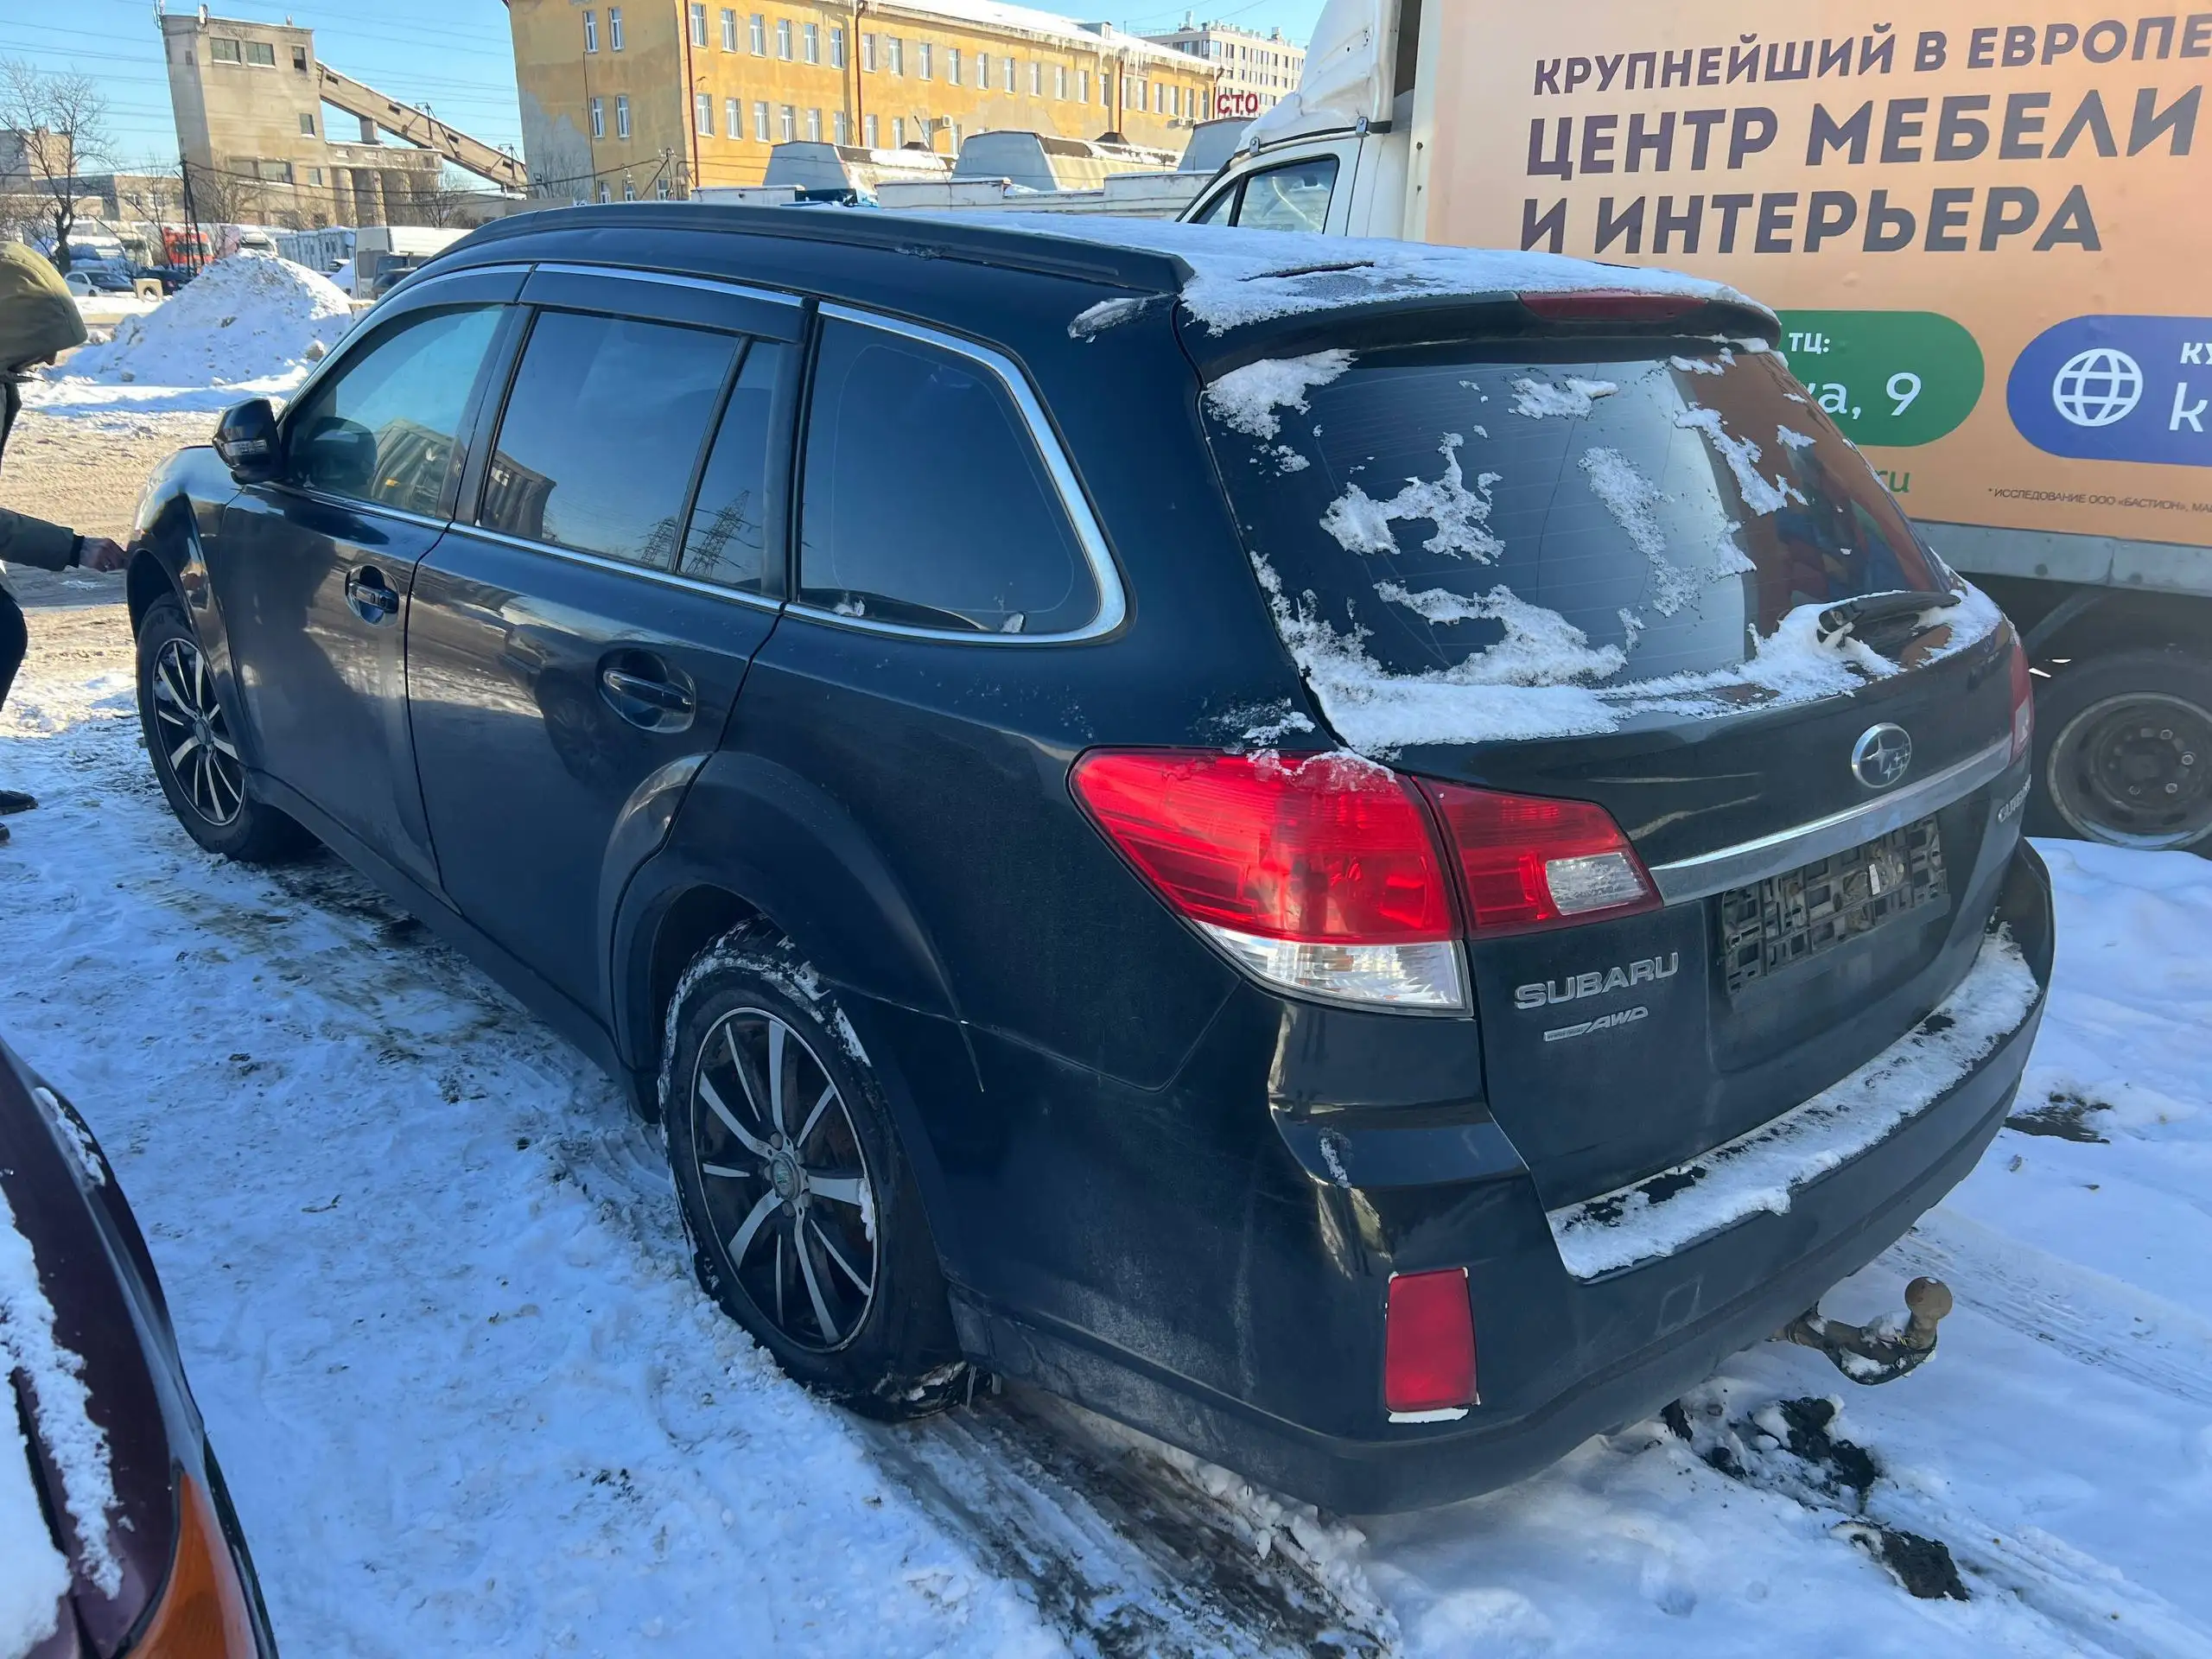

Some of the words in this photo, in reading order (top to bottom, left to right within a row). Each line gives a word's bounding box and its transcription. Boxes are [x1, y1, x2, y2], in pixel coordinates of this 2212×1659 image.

[1534, 22, 1897, 96] КРУПНЕЙШИЙ
[1913, 31, 1948, 72] В
[1967, 13, 2212, 69] ЕВРОПЕ
[1217, 92, 1258, 113] СТО
[1527, 106, 1778, 181] ЦЕНТР
[1805, 85, 2203, 166] МЕБЕЛИ
[1520, 198, 1567, 254] И
[1594, 184, 2102, 254] ИНТЕРЬЕРА
[1789, 332, 1831, 355] ТЦ:
[1885, 372, 1923, 416] 9
[1514, 951, 1679, 1009] SUBARU
[1585, 1006, 1649, 1033] AWD
